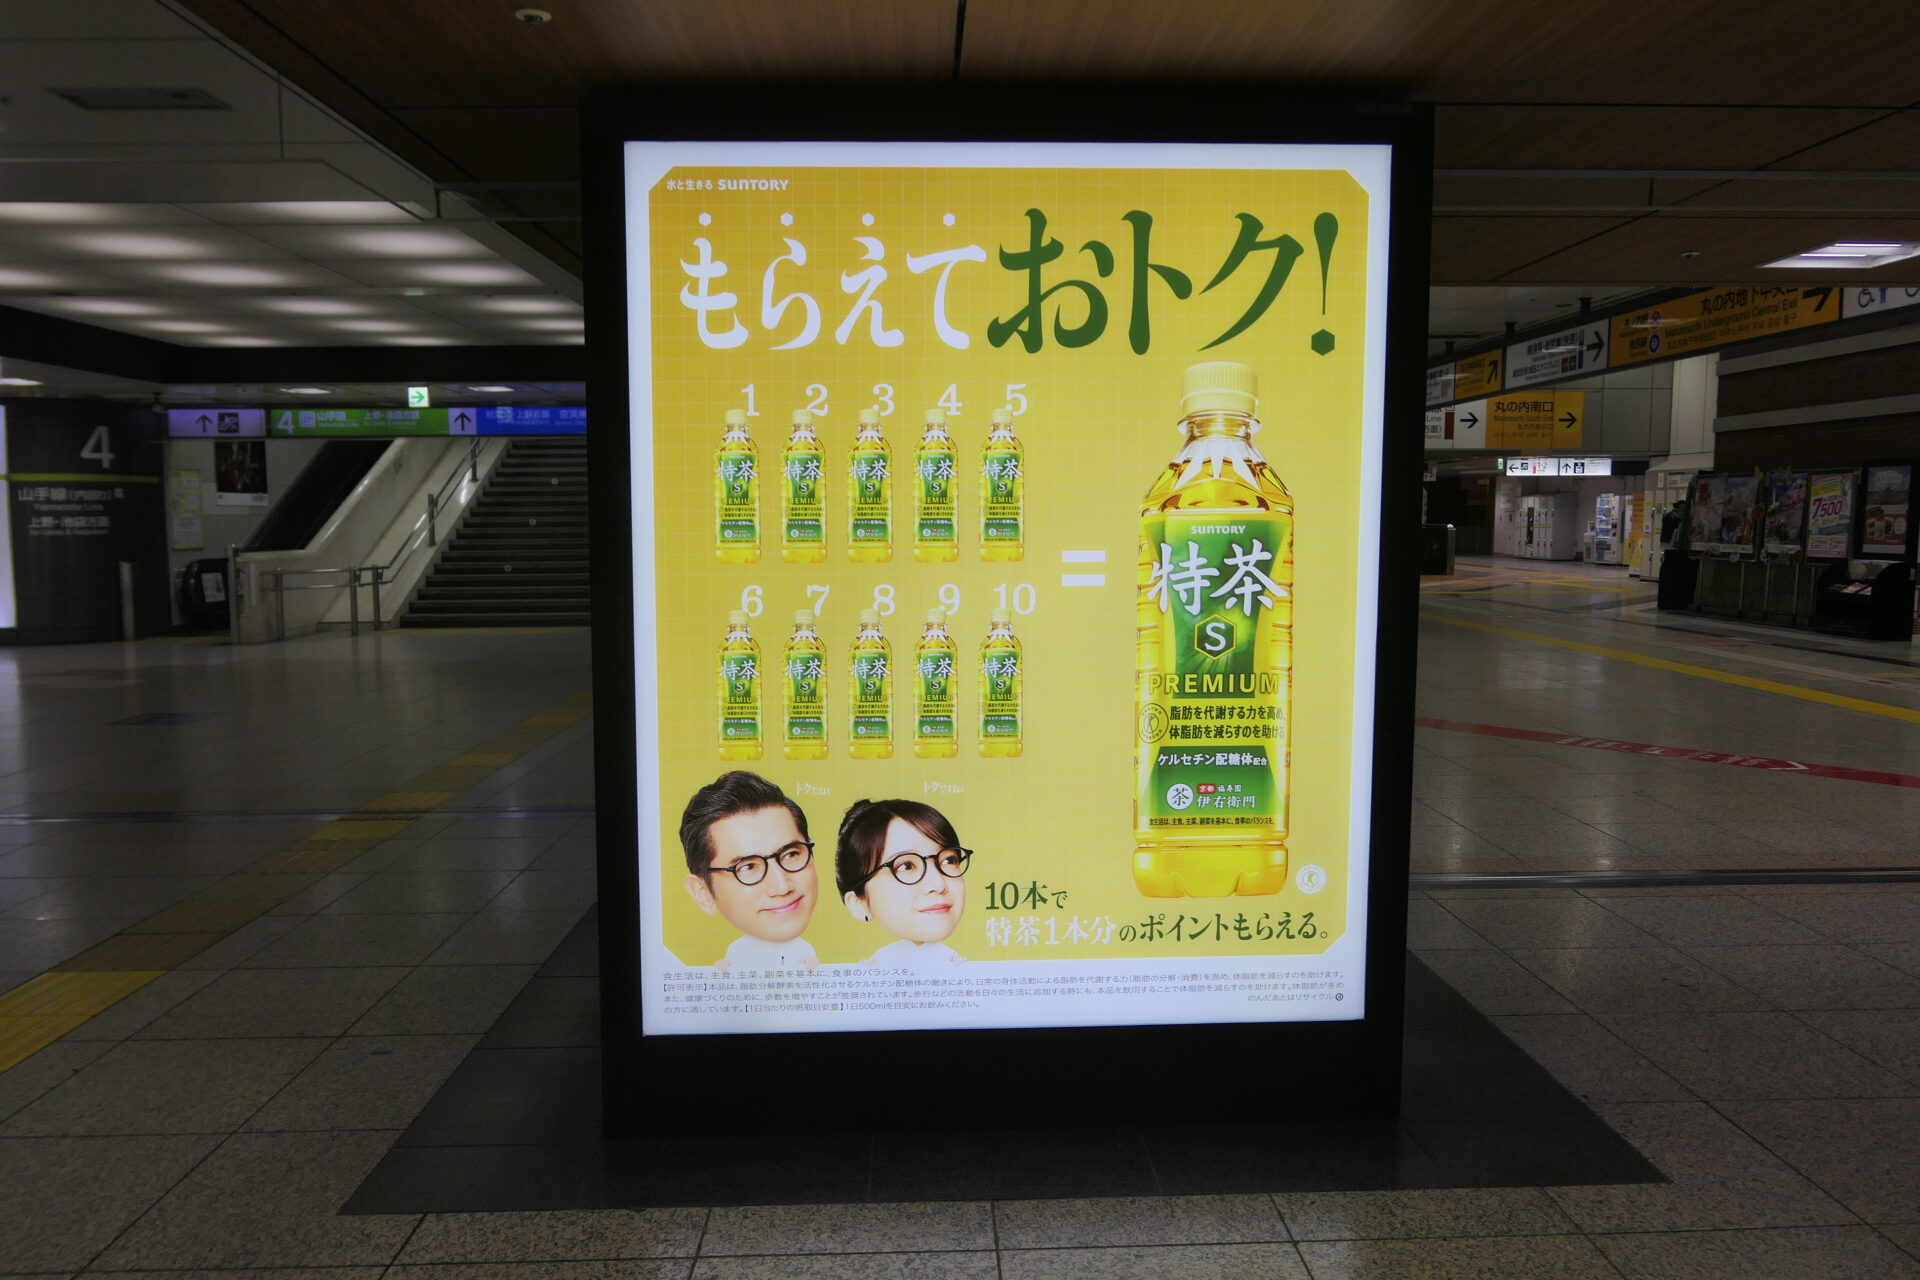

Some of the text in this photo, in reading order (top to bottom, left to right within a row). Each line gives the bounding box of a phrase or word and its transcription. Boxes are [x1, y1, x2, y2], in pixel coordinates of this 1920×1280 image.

[667, 179, 789, 196] 水と生きる SUNTORY
[741, 384, 1028, 416] 1 2 3 4 5
[1494, 401, 1554, 413] 丸の内南口
[278, 411, 294, 434] 4
[80, 425, 115, 470] 4
[717, 459, 759, 482] 特茶
[784, 459, 825, 482] 特茶
[850, 458, 892, 481] 特茶
[917, 458, 959, 481] 特茶
[982, 458, 1024, 480] 特茶
[733, 482, 744, 493] S
[799, 481, 809, 492] S
[865, 481, 874, 492] S
[931, 481, 940, 492] S
[996, 481, 1005, 491] S
[1191, 525, 1245, 534] SUNTORY
[1146, 539, 1288, 616] 特茶
[742, 584, 1036, 617] 6 7 8 9 10
[1205, 622, 1226, 651] S
[720, 659, 761, 681] 特茶
[785, 659, 826, 680] 特茶
[851, 658, 891, 680] 特茶
[917, 657, 958, 679] 特茶
[981, 657, 1022, 678] 特茶
[735, 682, 745, 692] S
[801, 681, 811, 691] S
[866, 681, 875, 691] S
[931, 680, 940, 690] S
[996, 680, 1005, 690] S
[1149, 673, 1279, 695] PREMIUM
[1171, 788, 1192, 808] 茶
[984, 880, 1068, 910] 10本で
